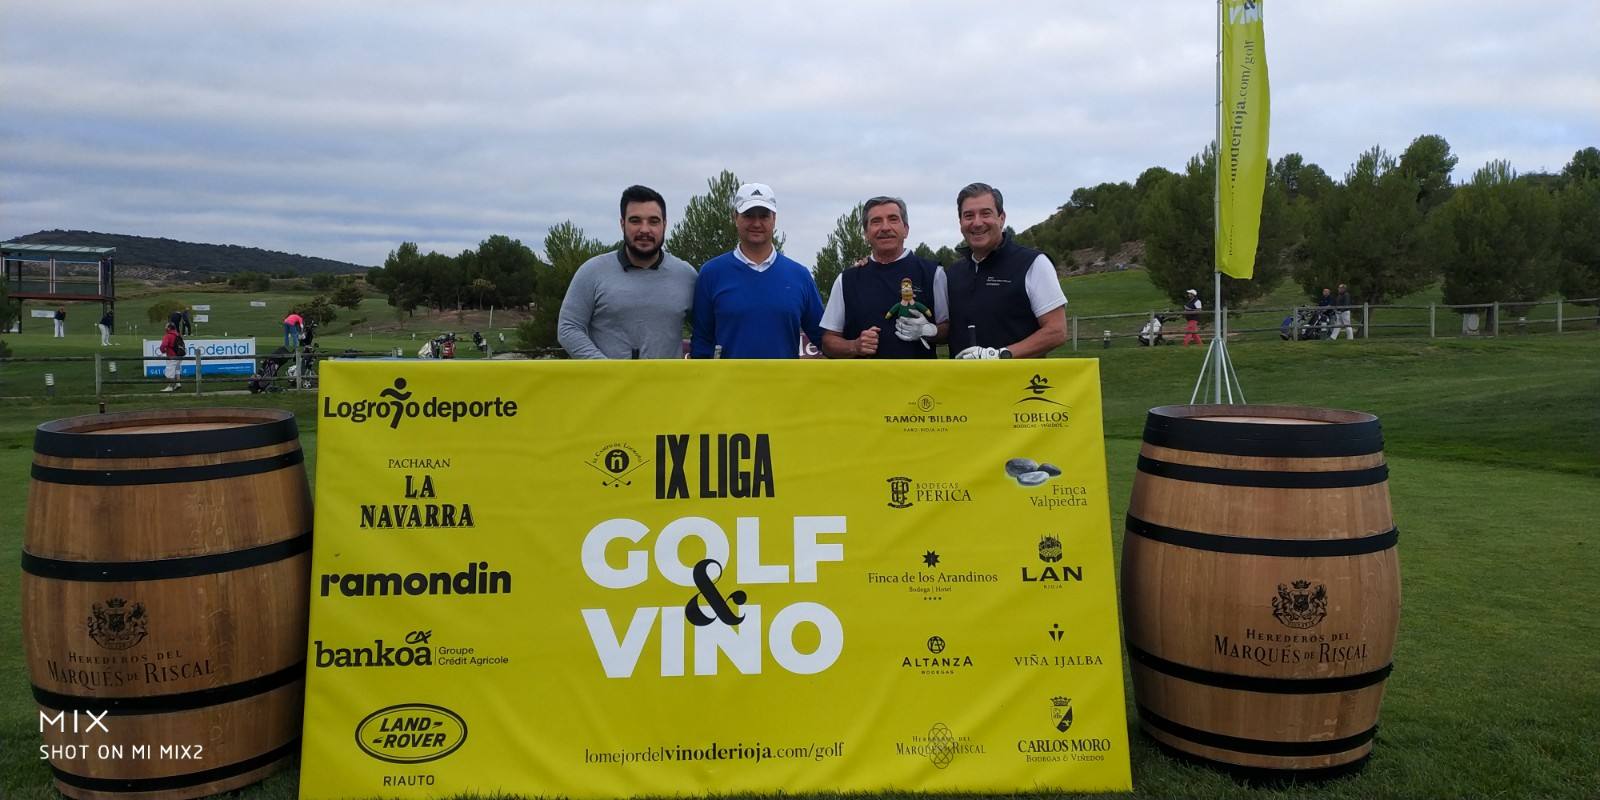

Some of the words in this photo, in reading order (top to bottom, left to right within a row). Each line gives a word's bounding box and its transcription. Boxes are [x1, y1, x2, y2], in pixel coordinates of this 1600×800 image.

[423, 397, 518, 422] deporte
[1013, 411, 1069, 423] TOBELOS
[928, 415, 968, 423] BILBAO
[388, 458, 451, 469] PACHARAN
[655, 434, 690, 499] IX
[700, 433, 775, 499] LIGA
[404, 474, 436, 498] LA
[916, 482, 959, 490] BODEGAS
[1052, 484, 1087, 496] Finca
[917, 489, 973, 502] PERICA
[1029, 496, 1088, 511] Valpiedra
[359, 504, 475, 529] NAVARRA
[581, 515, 847, 589] GOLF
[320, 562, 511, 597] ramondin
[868, 572, 898, 584] Finca
[901, 571, 915, 583] de
[918, 571, 935, 583] los
[938, 570, 998, 583] Arandinos
[1022, 566, 1083, 582] LAN
[685, 558, 748, 627] &
[581, 601, 844, 678] VINO
[1246, 628, 1325, 643] HEREDEROS
[68, 651, 149, 665] HEREDEROS
[156, 650, 184, 661] DEL
[314, 640, 432, 668] bankoa
[438, 646, 474, 656] Groupe
[1214, 635, 1300, 666] MARQUÉS
[1303, 650, 1315, 659] DE
[1318, 642, 1368, 664] RISCAL
[438, 655, 467, 666] Crédit
[469, 655, 509, 667] Agricole
[902, 656, 973, 667] ALTANZA
[1014, 654, 1049, 667] VIÑA
[1054, 655, 1103, 668] IJALBA
[47, 660, 125, 690] MARQUÉS
[126, 671, 140, 682] DE
[143, 659, 215, 685] RISCAL
[952, 741, 987, 754] RISCAL
[1017, 739, 1069, 753] CARLOS
[1071, 738, 1111, 752] MORO
[584, 741, 845, 767] lomejordelvinoderioja.com/golf
[1026, 754, 1061, 762] BODEGAS
[383, 774, 435, 787] RIAUTO
